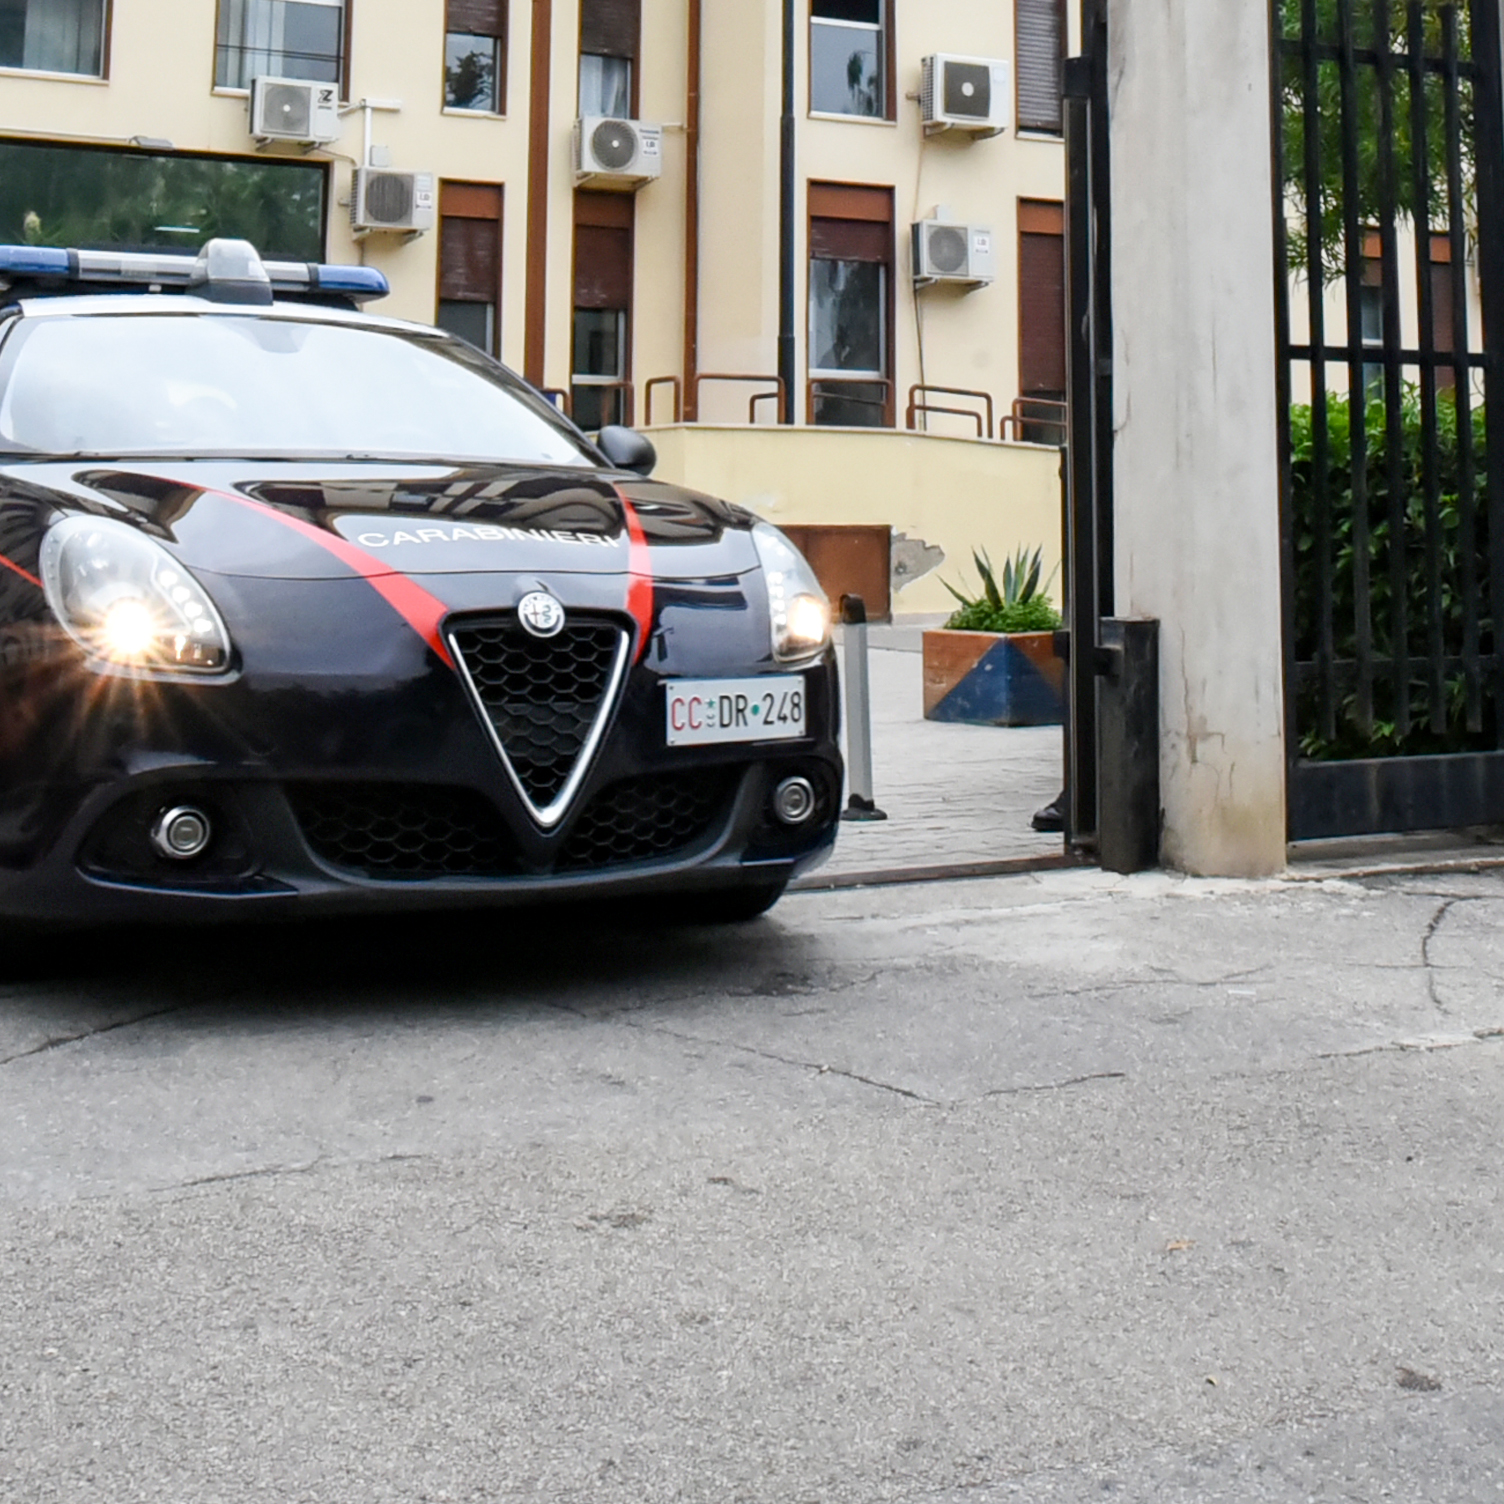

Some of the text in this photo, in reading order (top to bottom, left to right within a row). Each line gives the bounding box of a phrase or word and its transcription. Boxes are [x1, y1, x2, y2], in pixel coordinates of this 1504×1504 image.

[357, 527, 620, 548] CARABINIERI
[671, 691, 802, 731] CC DR 248
